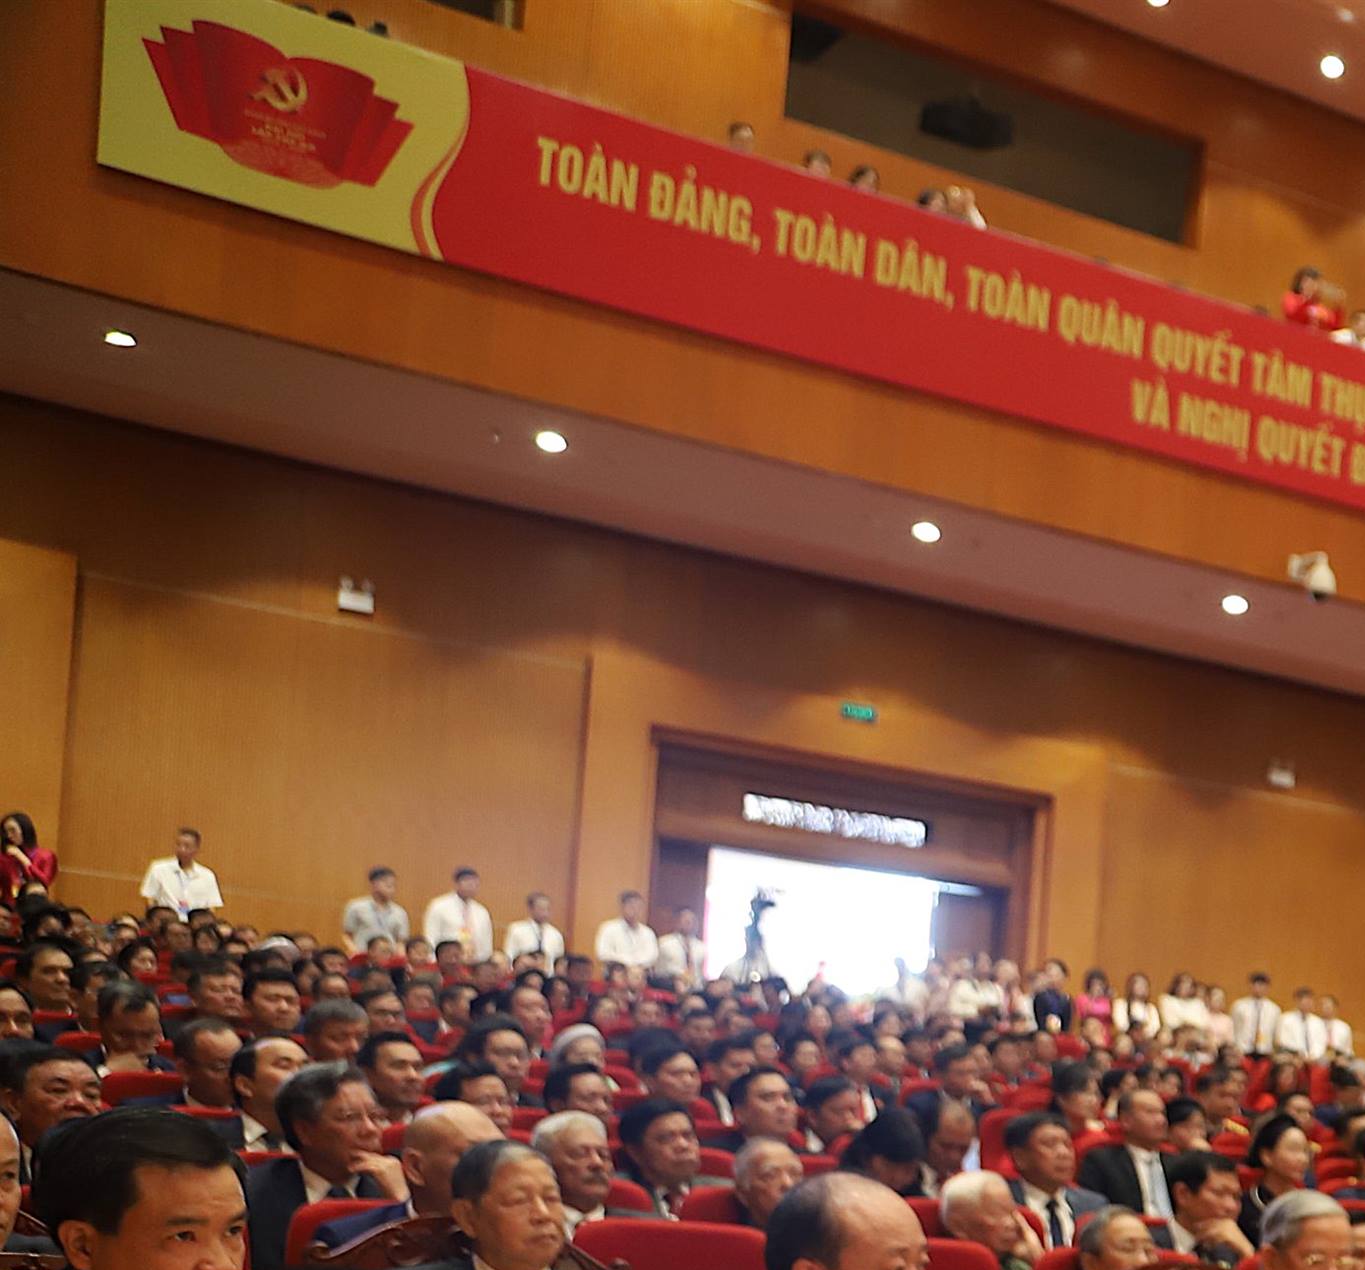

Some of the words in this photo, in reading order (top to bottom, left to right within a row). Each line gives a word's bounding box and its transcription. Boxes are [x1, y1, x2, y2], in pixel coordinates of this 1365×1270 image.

[537, 136, 639, 212] TOÀN
[648, 164, 761, 255] ĐẢNG,
[774, 210, 866, 279] TOÀN
[874, 239, 955, 310] DÂN,
[966, 265, 1050, 332] TOÀN
[1058, 295, 1145, 358] QUÂN
[1151, 322, 1245, 387] QUYẾT
[1252, 349, 1314, 409] TÂM
[1131, 375, 1171, 432] VÀ
[1177, 392, 1251, 463] NGHỊ
[1257, 415, 1345, 478] QUYẾT
